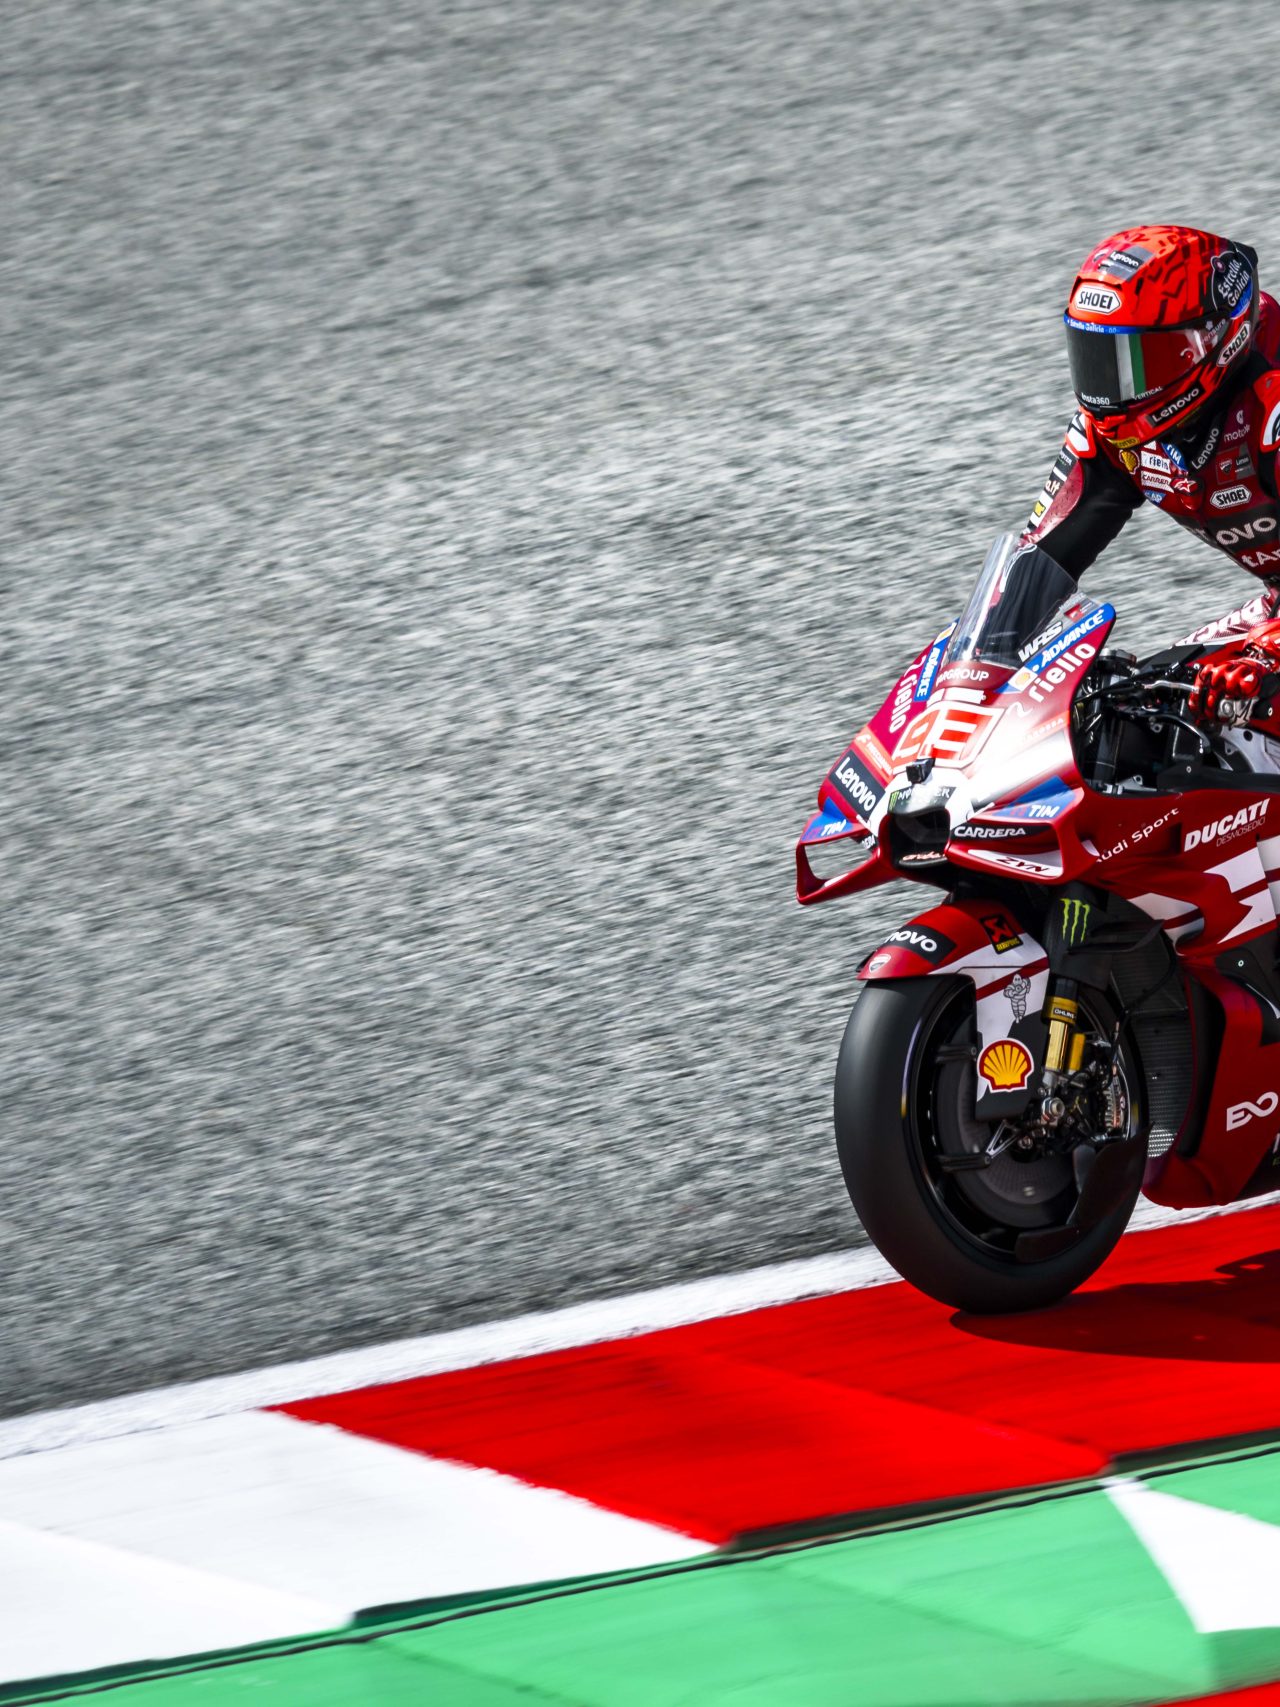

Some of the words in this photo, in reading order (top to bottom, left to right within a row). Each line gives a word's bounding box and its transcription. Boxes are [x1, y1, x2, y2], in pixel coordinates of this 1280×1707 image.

[1110, 251, 1139, 267] Lenovo
[1218, 256, 1242, 297] Estrella
[1078, 290, 1114, 310] SHOEI
[1227, 271, 1250, 308] Galicia
[1222, 325, 1249, 363] SHOEI
[1152, 387, 1200, 423] Lenovo
[1191, 428, 1220, 470] Lenovo
[1217, 489, 1247, 506] SHOEI
[1018, 621, 1063, 662] WRS
[1041, 608, 1105, 668] ADVANCE
[1029, 643, 1096, 702] riello
[835, 756, 877, 811] Lenovo
[1027, 803, 1059, 818] TIM
[1131, 808, 1179, 843] Sport
[1184, 798, 1271, 852] DUCATI
[954, 825, 1026, 839] CARRERA
